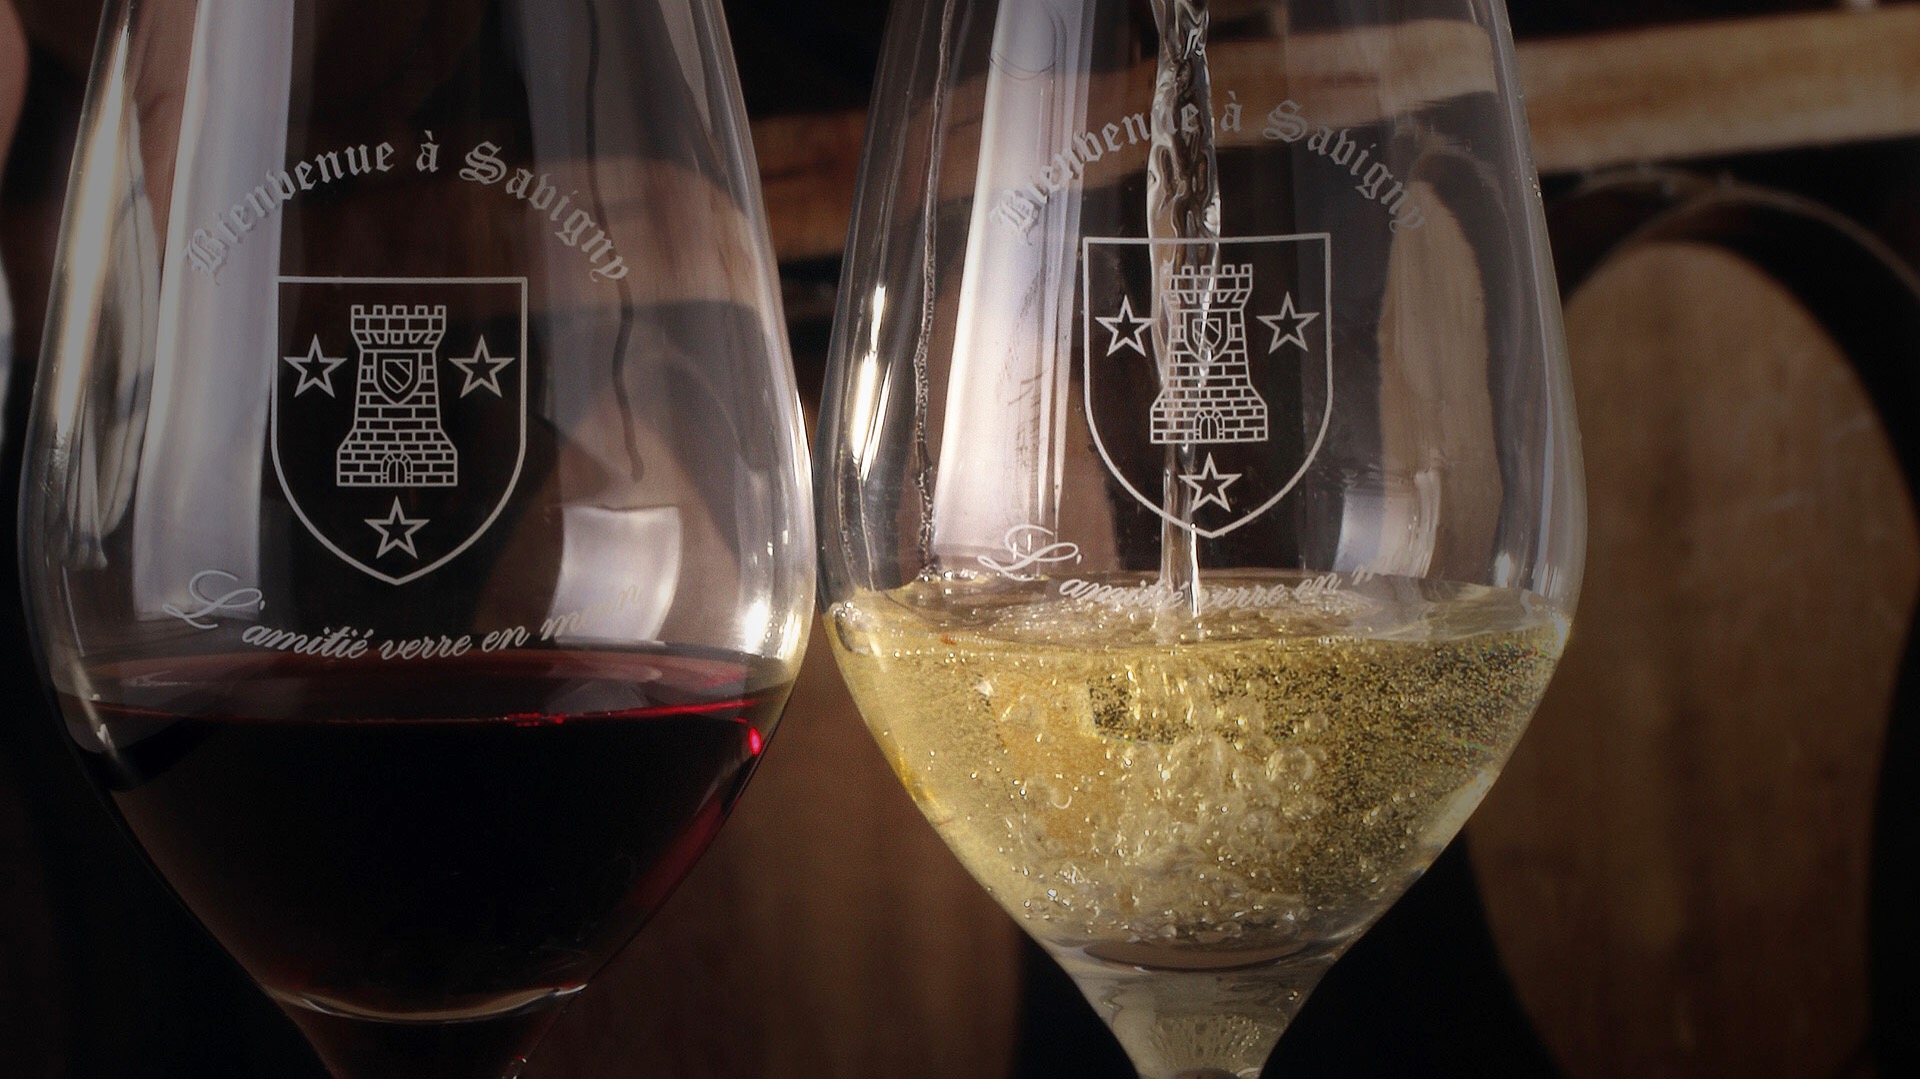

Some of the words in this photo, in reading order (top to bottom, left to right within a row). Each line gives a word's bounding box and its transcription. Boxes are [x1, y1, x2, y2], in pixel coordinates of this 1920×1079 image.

[183, 141, 395, 285] Bienvenue
[416, 130, 440, 173] à
[459, 140, 629, 283] Savigny
[1220, 91, 1242, 133] à
[1262, 100, 1426, 232] Savigny
[162, 569, 265, 629] L'
[242, 625, 374, 659] amitié
[378, 632, 471, 660] verre
[482, 625, 530, 653] en
